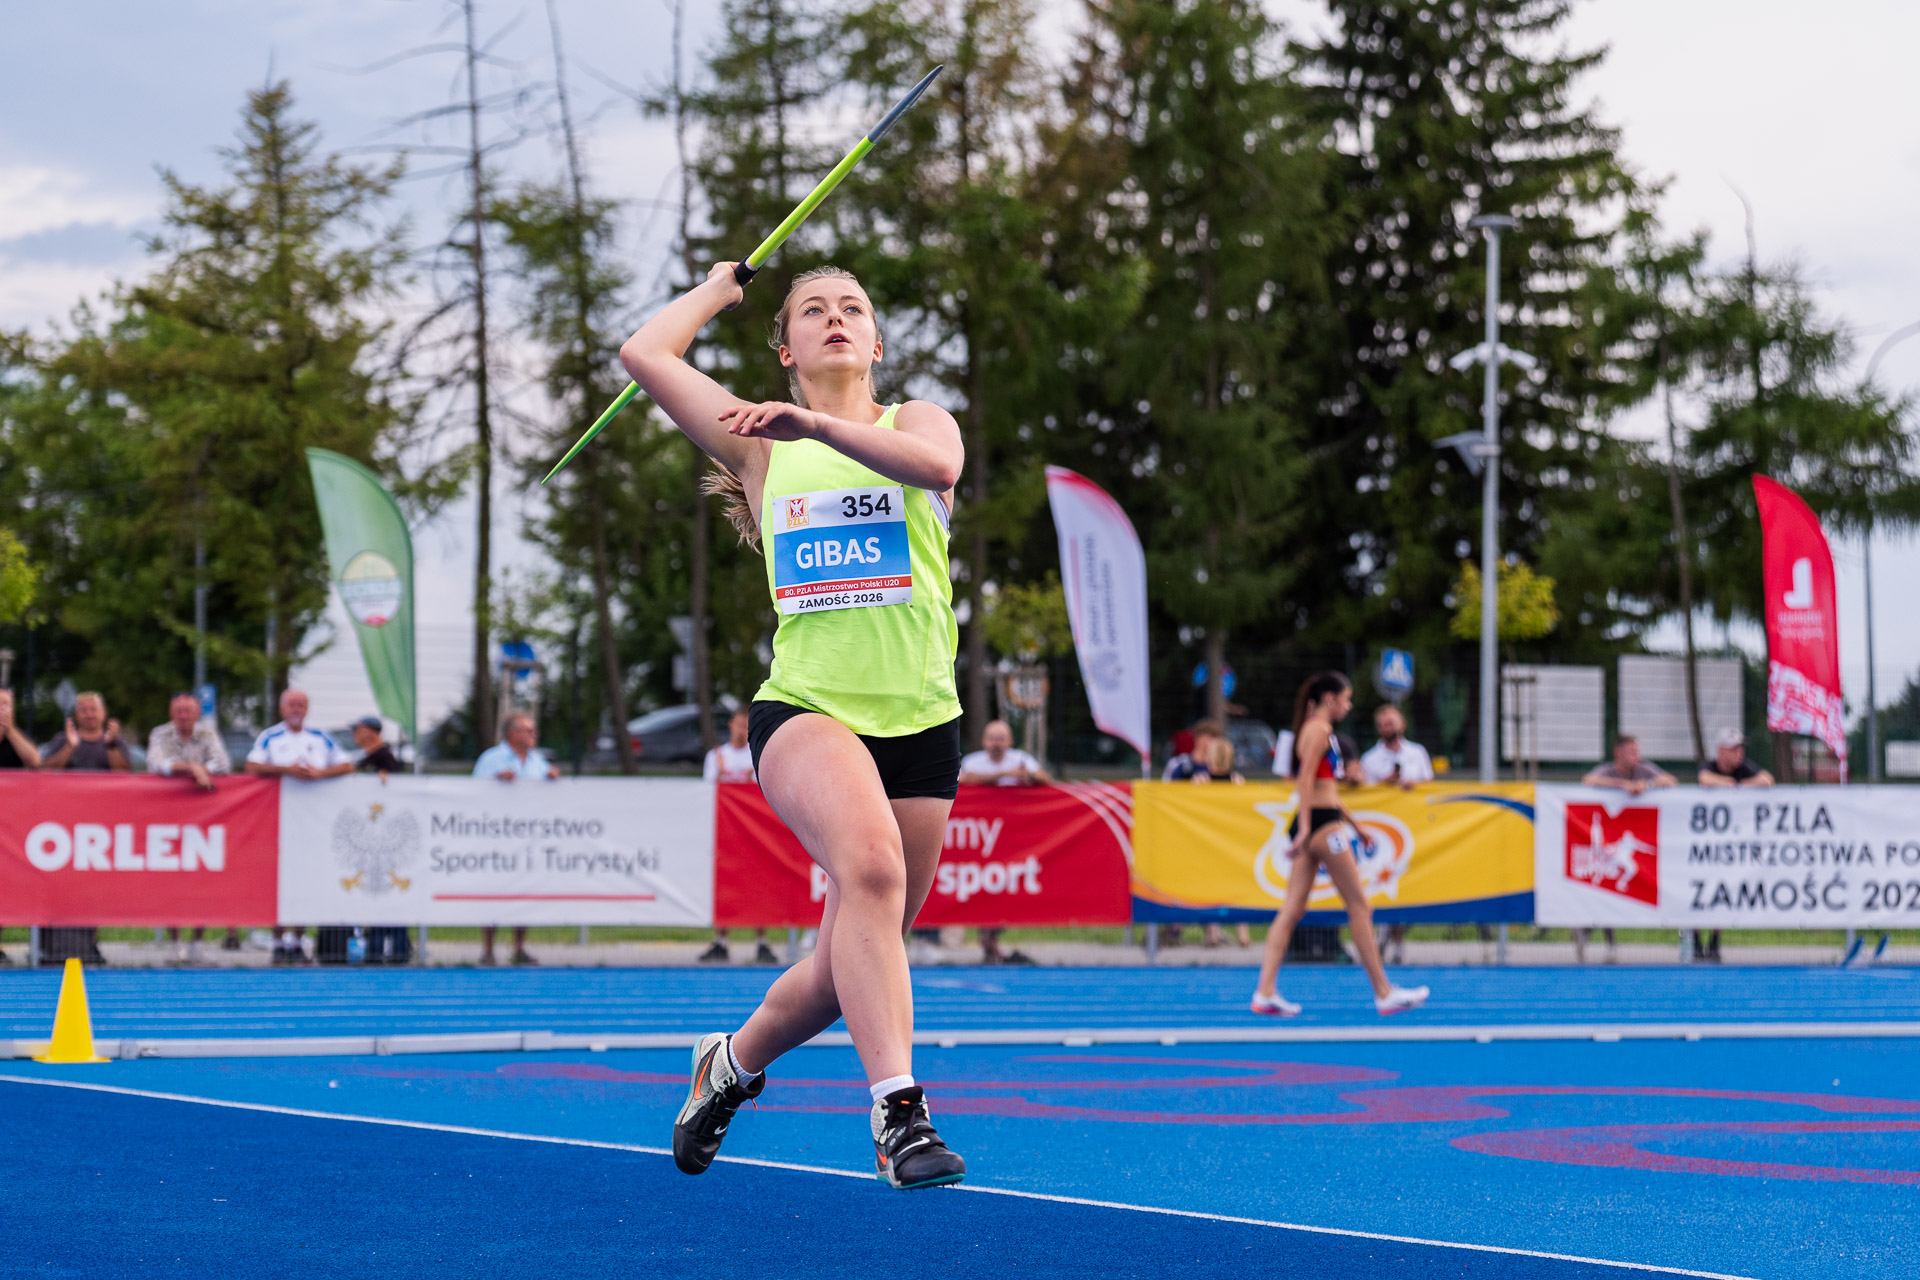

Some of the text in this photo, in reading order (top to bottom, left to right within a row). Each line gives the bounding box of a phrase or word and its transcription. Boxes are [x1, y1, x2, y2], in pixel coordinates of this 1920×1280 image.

[841, 493, 892, 518] 354
[787, 516, 808, 528] PZLA
[796, 536, 882, 569] GIBAS
[784, 578, 900, 597] 80. PZLA Mistrzostwa Polski U20
[798, 592, 883, 609] ZAMOŚĆ 2026
[430, 813, 604, 838] Ministerstwo
[1690, 803, 1834, 834] 80. PZLA
[25, 821, 226, 872] ORLEN
[1688, 840, 1874, 867] MISTRZOSTWA
[429, 847, 660, 876] Sportu i Turystyki
[936, 855, 1042, 903] sport
[1690, 872, 1847, 911] ZAMOŚĆ
